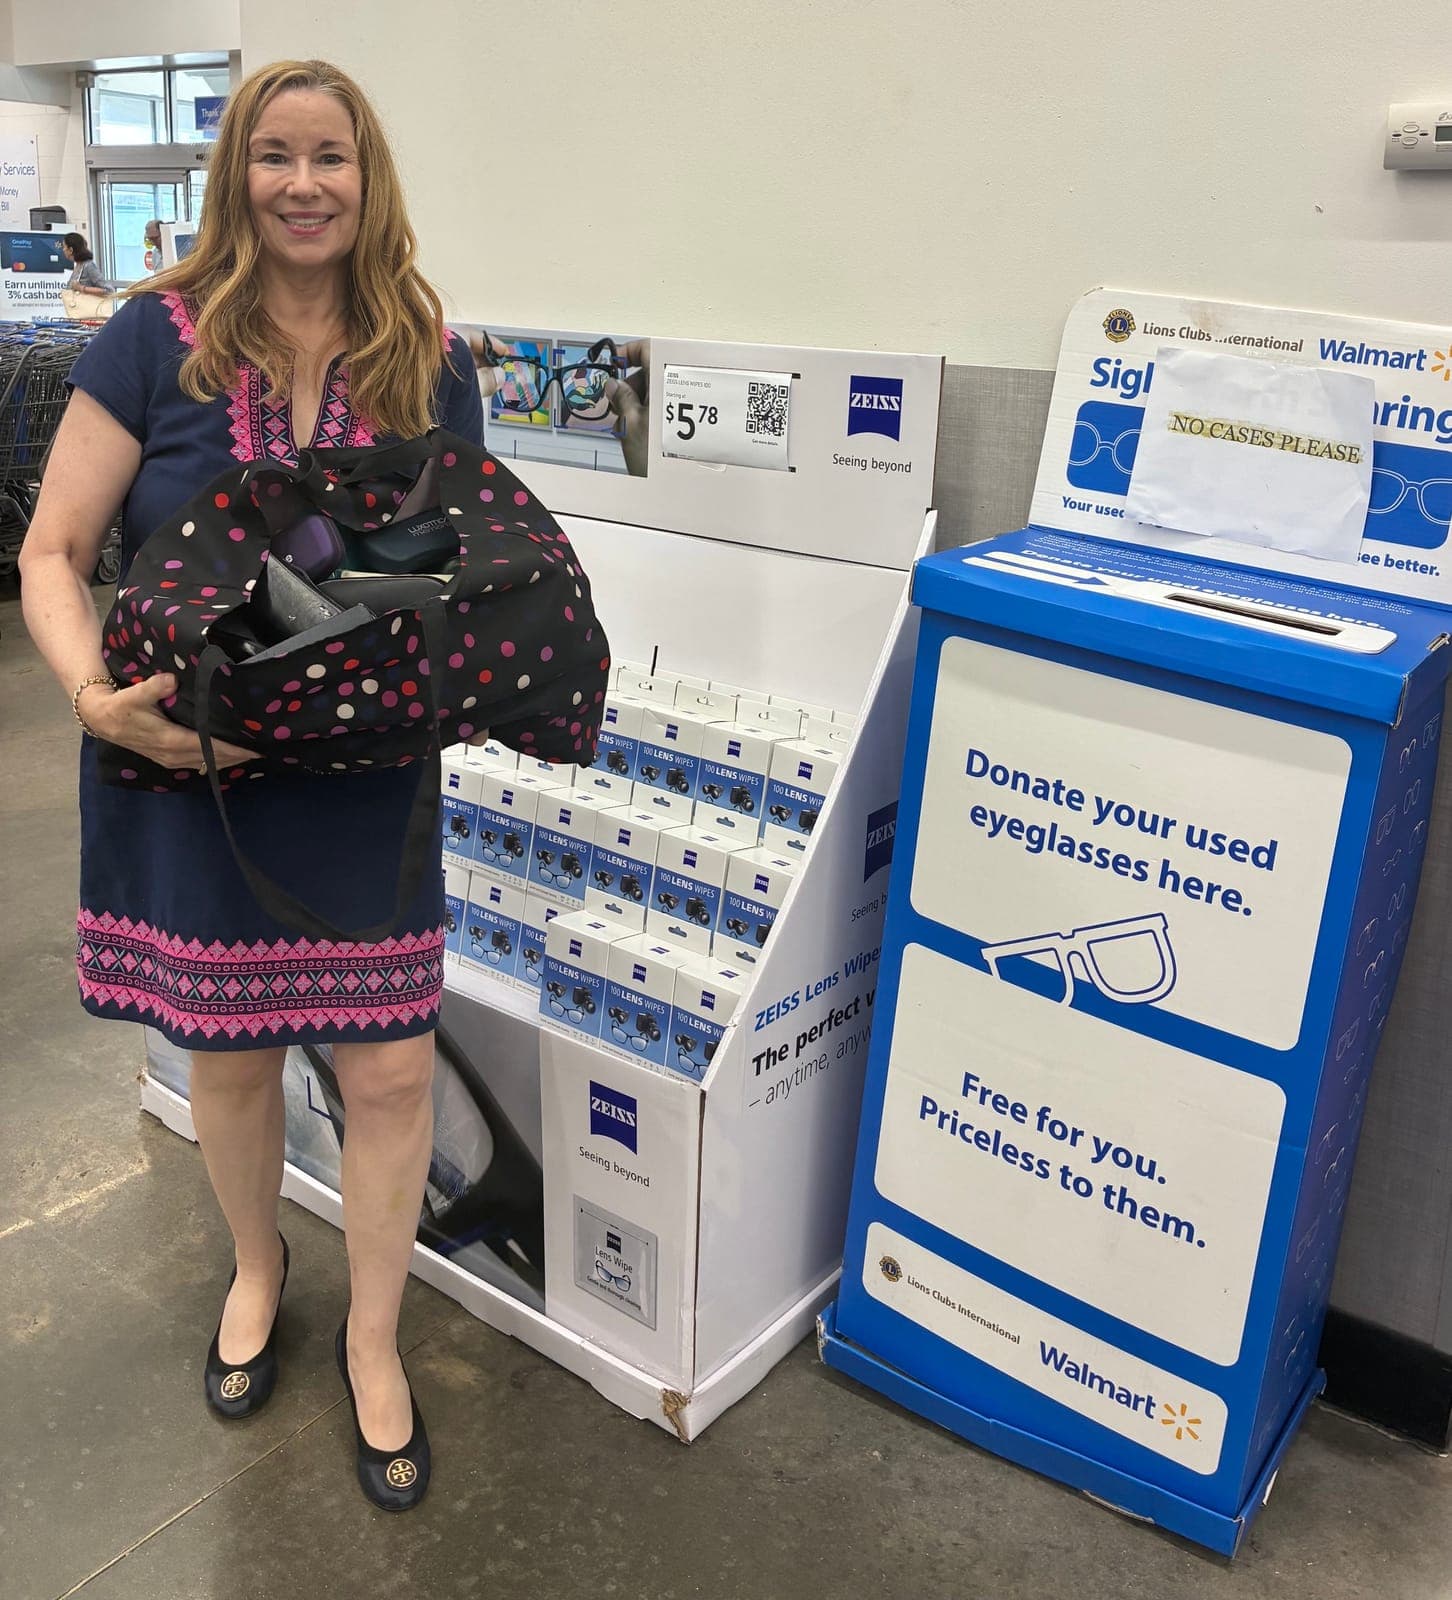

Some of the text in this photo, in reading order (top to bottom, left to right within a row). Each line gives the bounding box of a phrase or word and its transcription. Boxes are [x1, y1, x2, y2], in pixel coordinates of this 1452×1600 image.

[4, 162, 35, 176] Services
[5, 280, 68, 290] Earn unlimite
[8, 290, 63, 299] 3% cash bac
[1143, 322, 1176, 338] Lions
[1179, 326, 1212, 342] Clubs
[1319, 338, 1427, 371] Walmart
[850, 392, 900, 412] ZEISS
[1171, 414, 1361, 464] NO CASES PLEASE
[832, 453, 912, 473] Seeing beyond
[1062, 495, 1093, 513] Your
[1384, 554, 1440, 576] better.
[1021, 550, 1093, 568] Donate
[1092, 566, 1145, 579] your
[1147, 577, 1201, 591] used
[1202, 588, 1322, 616] eyeglasses
[1325, 612, 1386, 630] here.
[599, 733, 633, 750] ENS WIPES
[643, 746, 694, 768] 100 LENS WIPES
[705, 763, 760, 786] 100 LENS WIPES
[443, 798, 474, 815] ENS WIPES
[773, 784, 823, 807] 100 LENS WIP
[482, 810, 529, 833] 100 LENS WIPES
[966, 748, 1279, 871] Donate your used
[538, 830, 587, 853] 100 LENS WIPES
[867, 820, 896, 849] ZEIS
[597, 850, 648, 875] 100 LENS WIPES
[969, 803, 1252, 917] eyeglasses here.
[660, 872, 715, 899] 100 LENS WIPES
[471, 906, 517, 931] 100 LENS WIPES
[729, 896, 777, 921] 100 LENS WI
[851, 899, 879, 922] Seeing
[525, 928, 535, 939] 100
[548, 960, 600, 988] 100 LENS WIPES
[610, 985, 665, 1014] 100 LENS WIPES
[754, 990, 800, 1032] ZEISS
[805, 971, 839, 1002] Lens
[844, 945, 881, 978] Wipe
[677, 1012, 723, 1039] 100 LENS WI
[752, 1043, 789, 1077] The
[795, 994, 860, 1059] perfect
[765, 1052, 830, 1105] anytime,
[836, 1024, 872, 1060] anyw
[591, 1096, 636, 1127] ZEISS
[962, 1071, 1167, 1185] Free for you.
[579, 1146, 650, 1188] Seeing beyond
[920, 1094, 1206, 1249] Priceless to them.
[595, 1245, 633, 1273] Lens Wipe
[907, 1275, 1021, 1345] Lions Clubs International
[1039, 1340, 1157, 1420] Walmart
